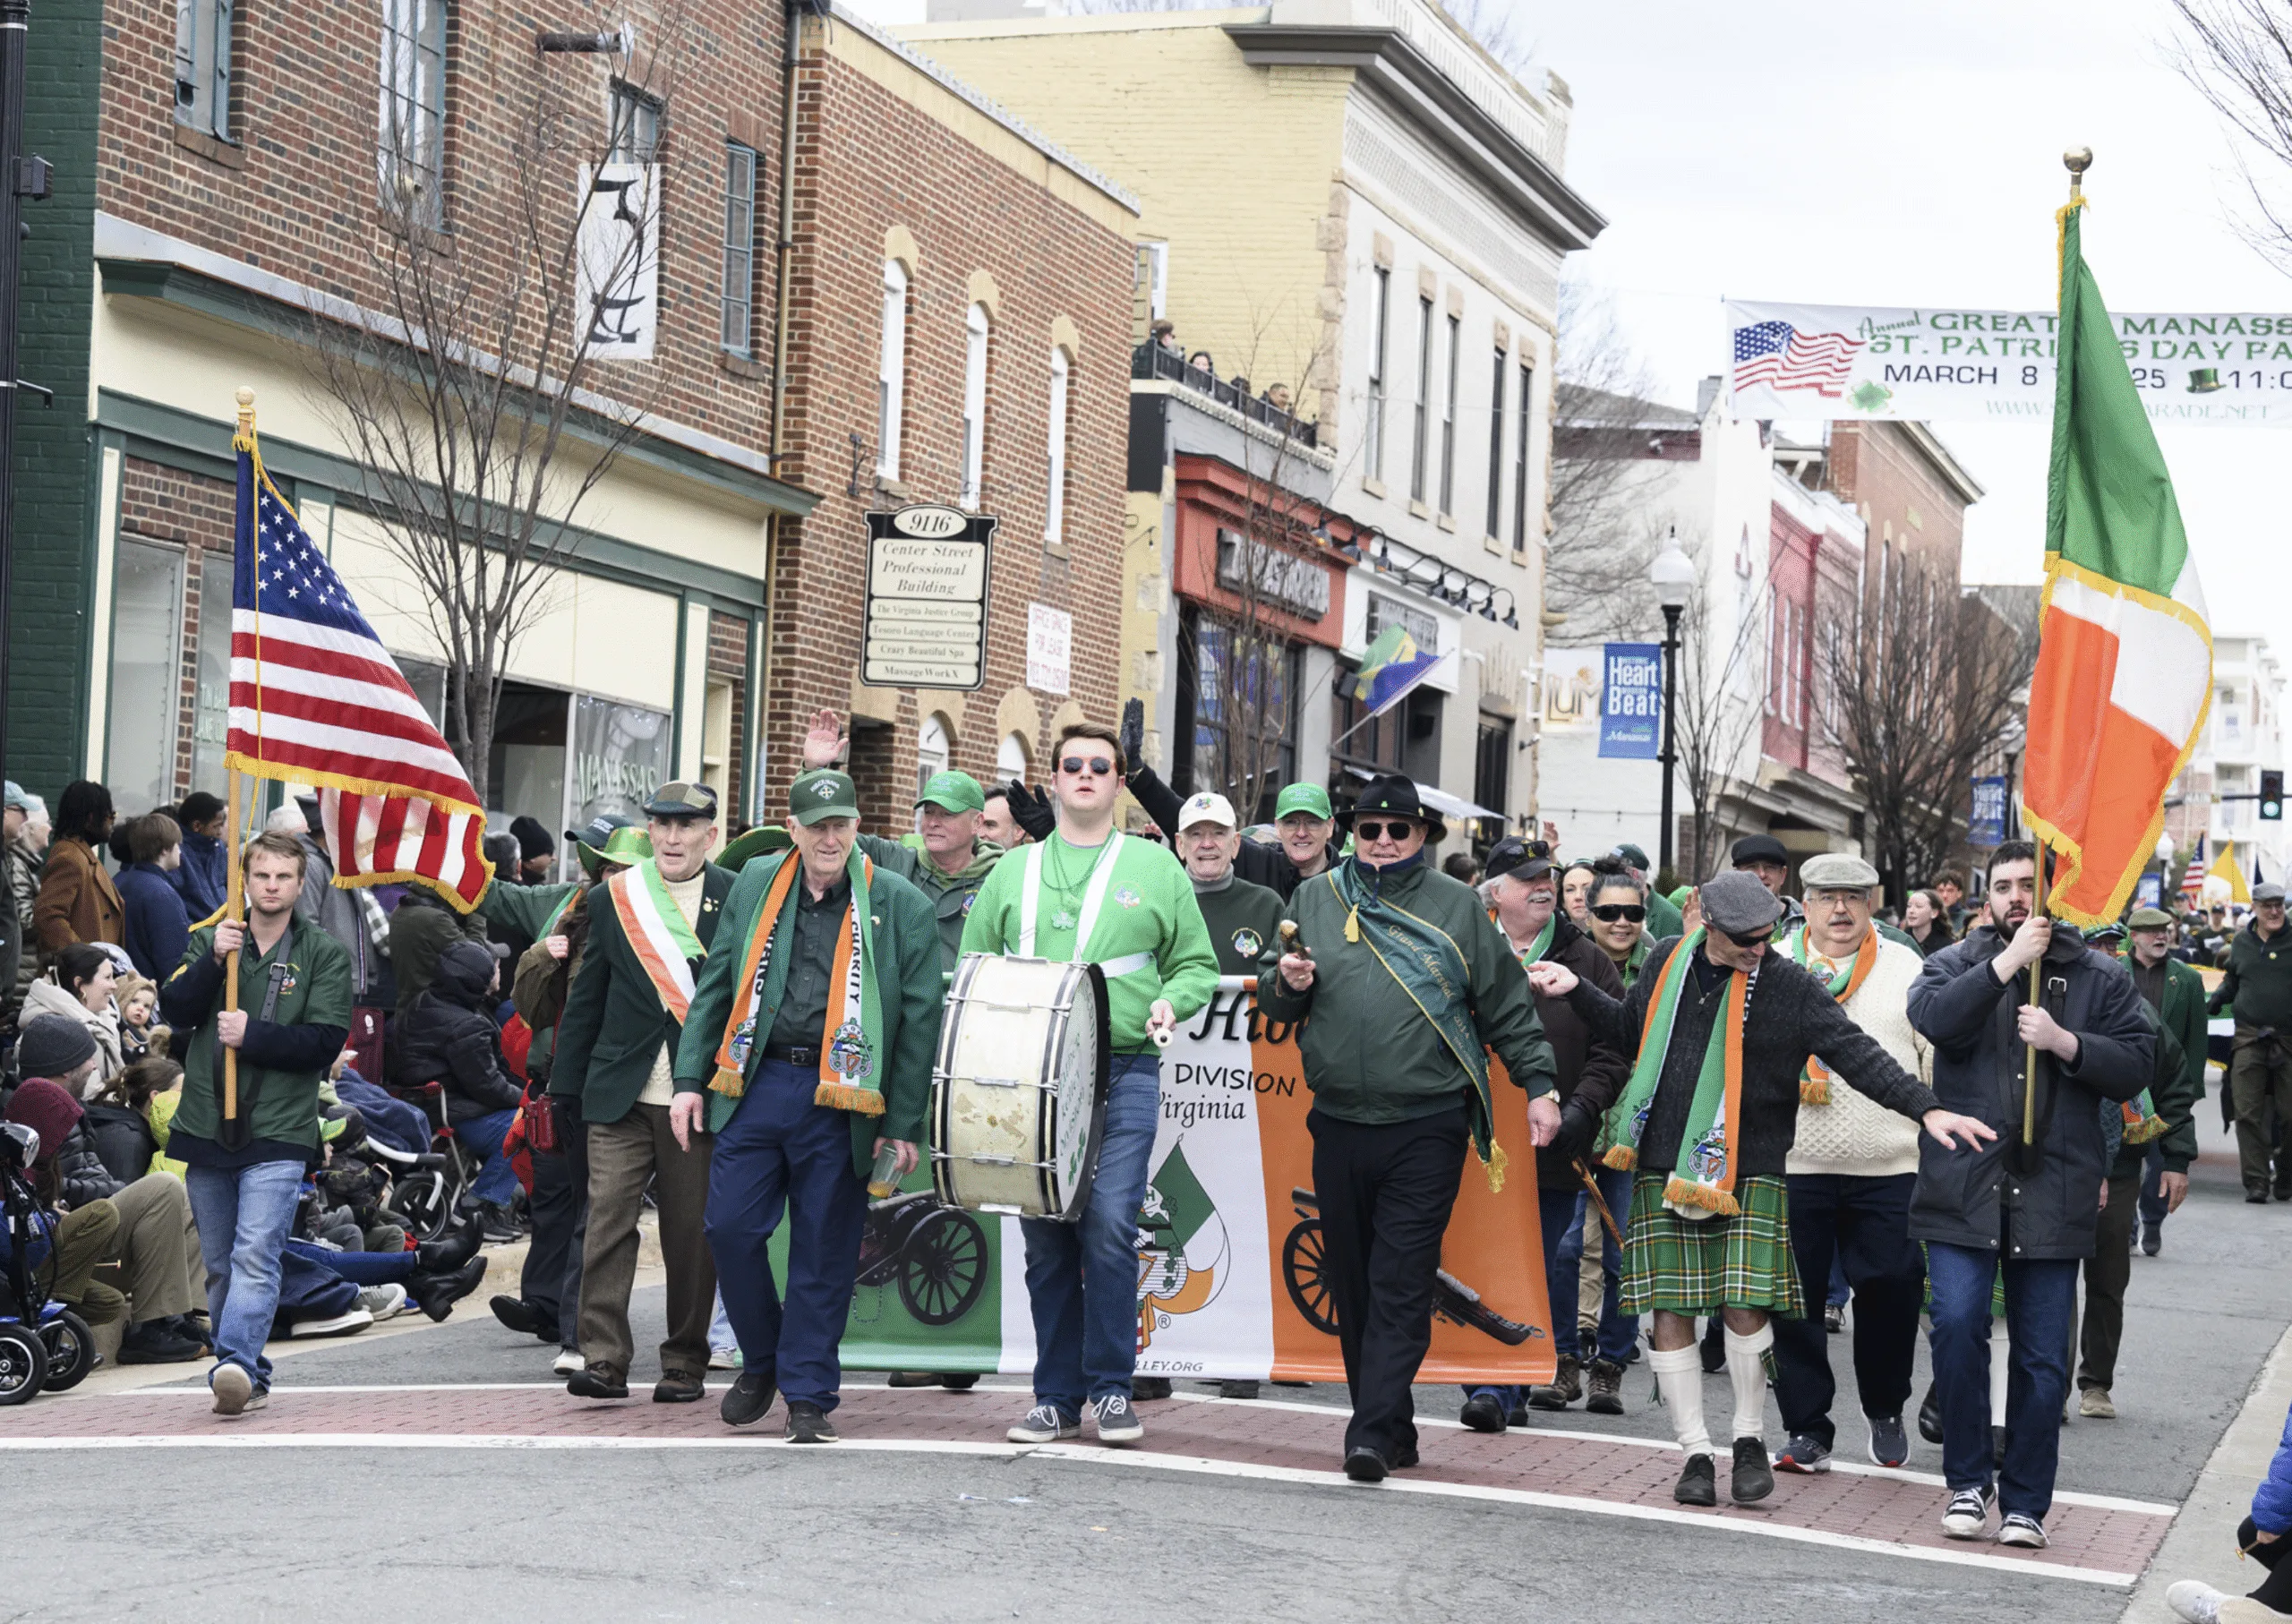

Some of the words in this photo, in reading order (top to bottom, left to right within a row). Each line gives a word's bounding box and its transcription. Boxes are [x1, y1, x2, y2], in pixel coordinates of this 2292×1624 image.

[1930, 313, 2059, 333] GREAT
[1869, 334, 1928, 355] ST.
[1941, 336, 2140, 359] PATRIS
[2151, 340, 2233, 360] DAY
[1885, 363, 1997, 384] MARCH
[2022, 365, 2038, 386] 8
[2132, 368, 2166, 389] 25
[910, 514, 952, 533] 9116
[883, 542, 927, 556] Center
[933, 545, 972, 558] Street
[883, 560, 967, 576] Professional
[897, 578, 956, 595] Building
[877, 604, 890, 613] The
[893, 606, 921, 616] Virginia
[951, 609, 974, 619] Group
[903, 627, 944, 638] Language
[946, 628, 975, 638] Center
[908, 645, 946, 656] Beautiful
[949, 648, 965, 659] Spa
[1609, 656, 1657, 687] Heart
[1608, 686, 1657, 716] Beat
[1388, 925, 1426, 952] Grand
[1421, 953, 1456, 999] Marshal
[1176, 1063, 1296, 1098] DIVISION
[1160, 1091, 1246, 1128] irginia
[1135, 1360, 1203, 1372] LLEY.ORG
